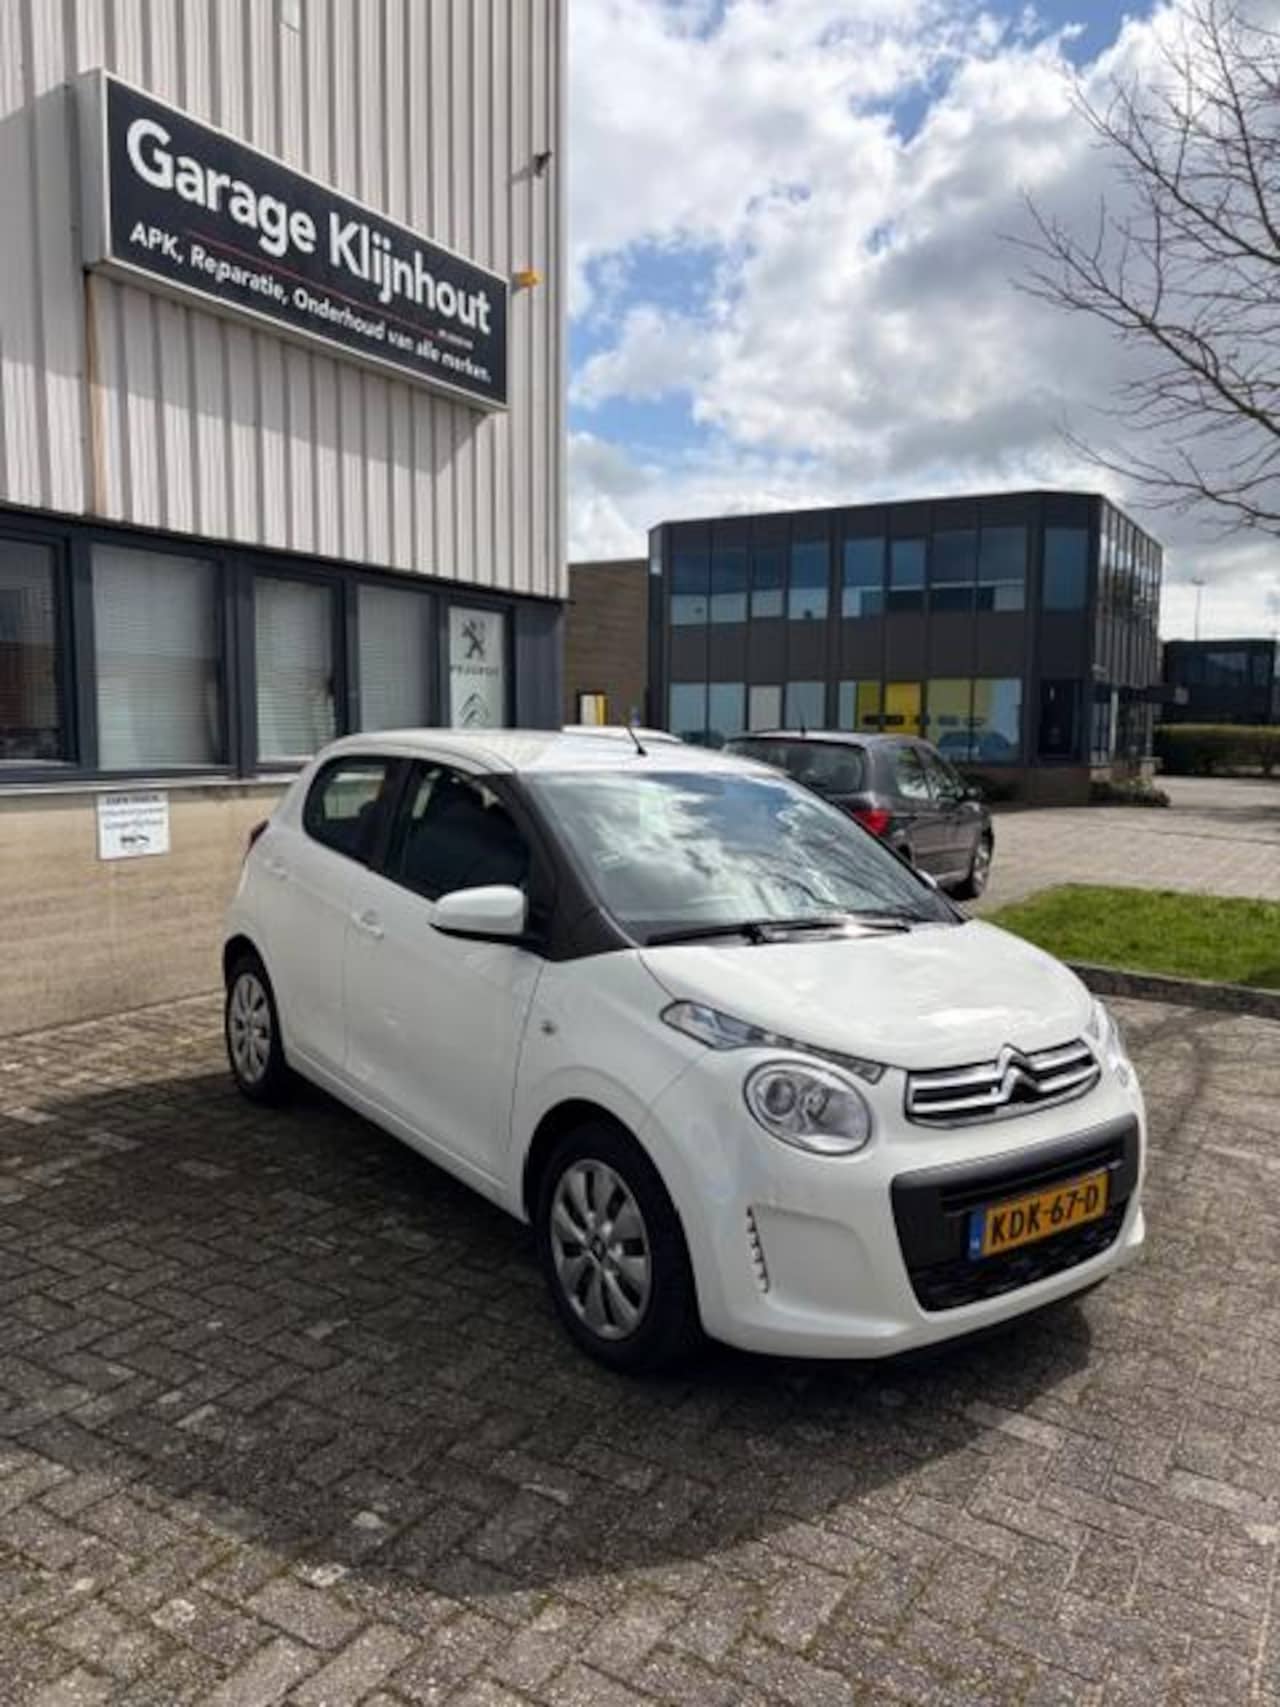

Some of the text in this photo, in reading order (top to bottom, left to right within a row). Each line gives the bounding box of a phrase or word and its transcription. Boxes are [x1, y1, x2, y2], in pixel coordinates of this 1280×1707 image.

[126, 118, 491, 334] Garage Klijnhout
[129, 221, 184, 264] APK,
[190, 245, 289, 306] Reparatie,
[293, 287, 385, 340] Onderhoud
[388, 331, 414, 350] van
[415, 340, 440, 361] alle
[991, 1184, 1099, 1245] KDK-67-D
